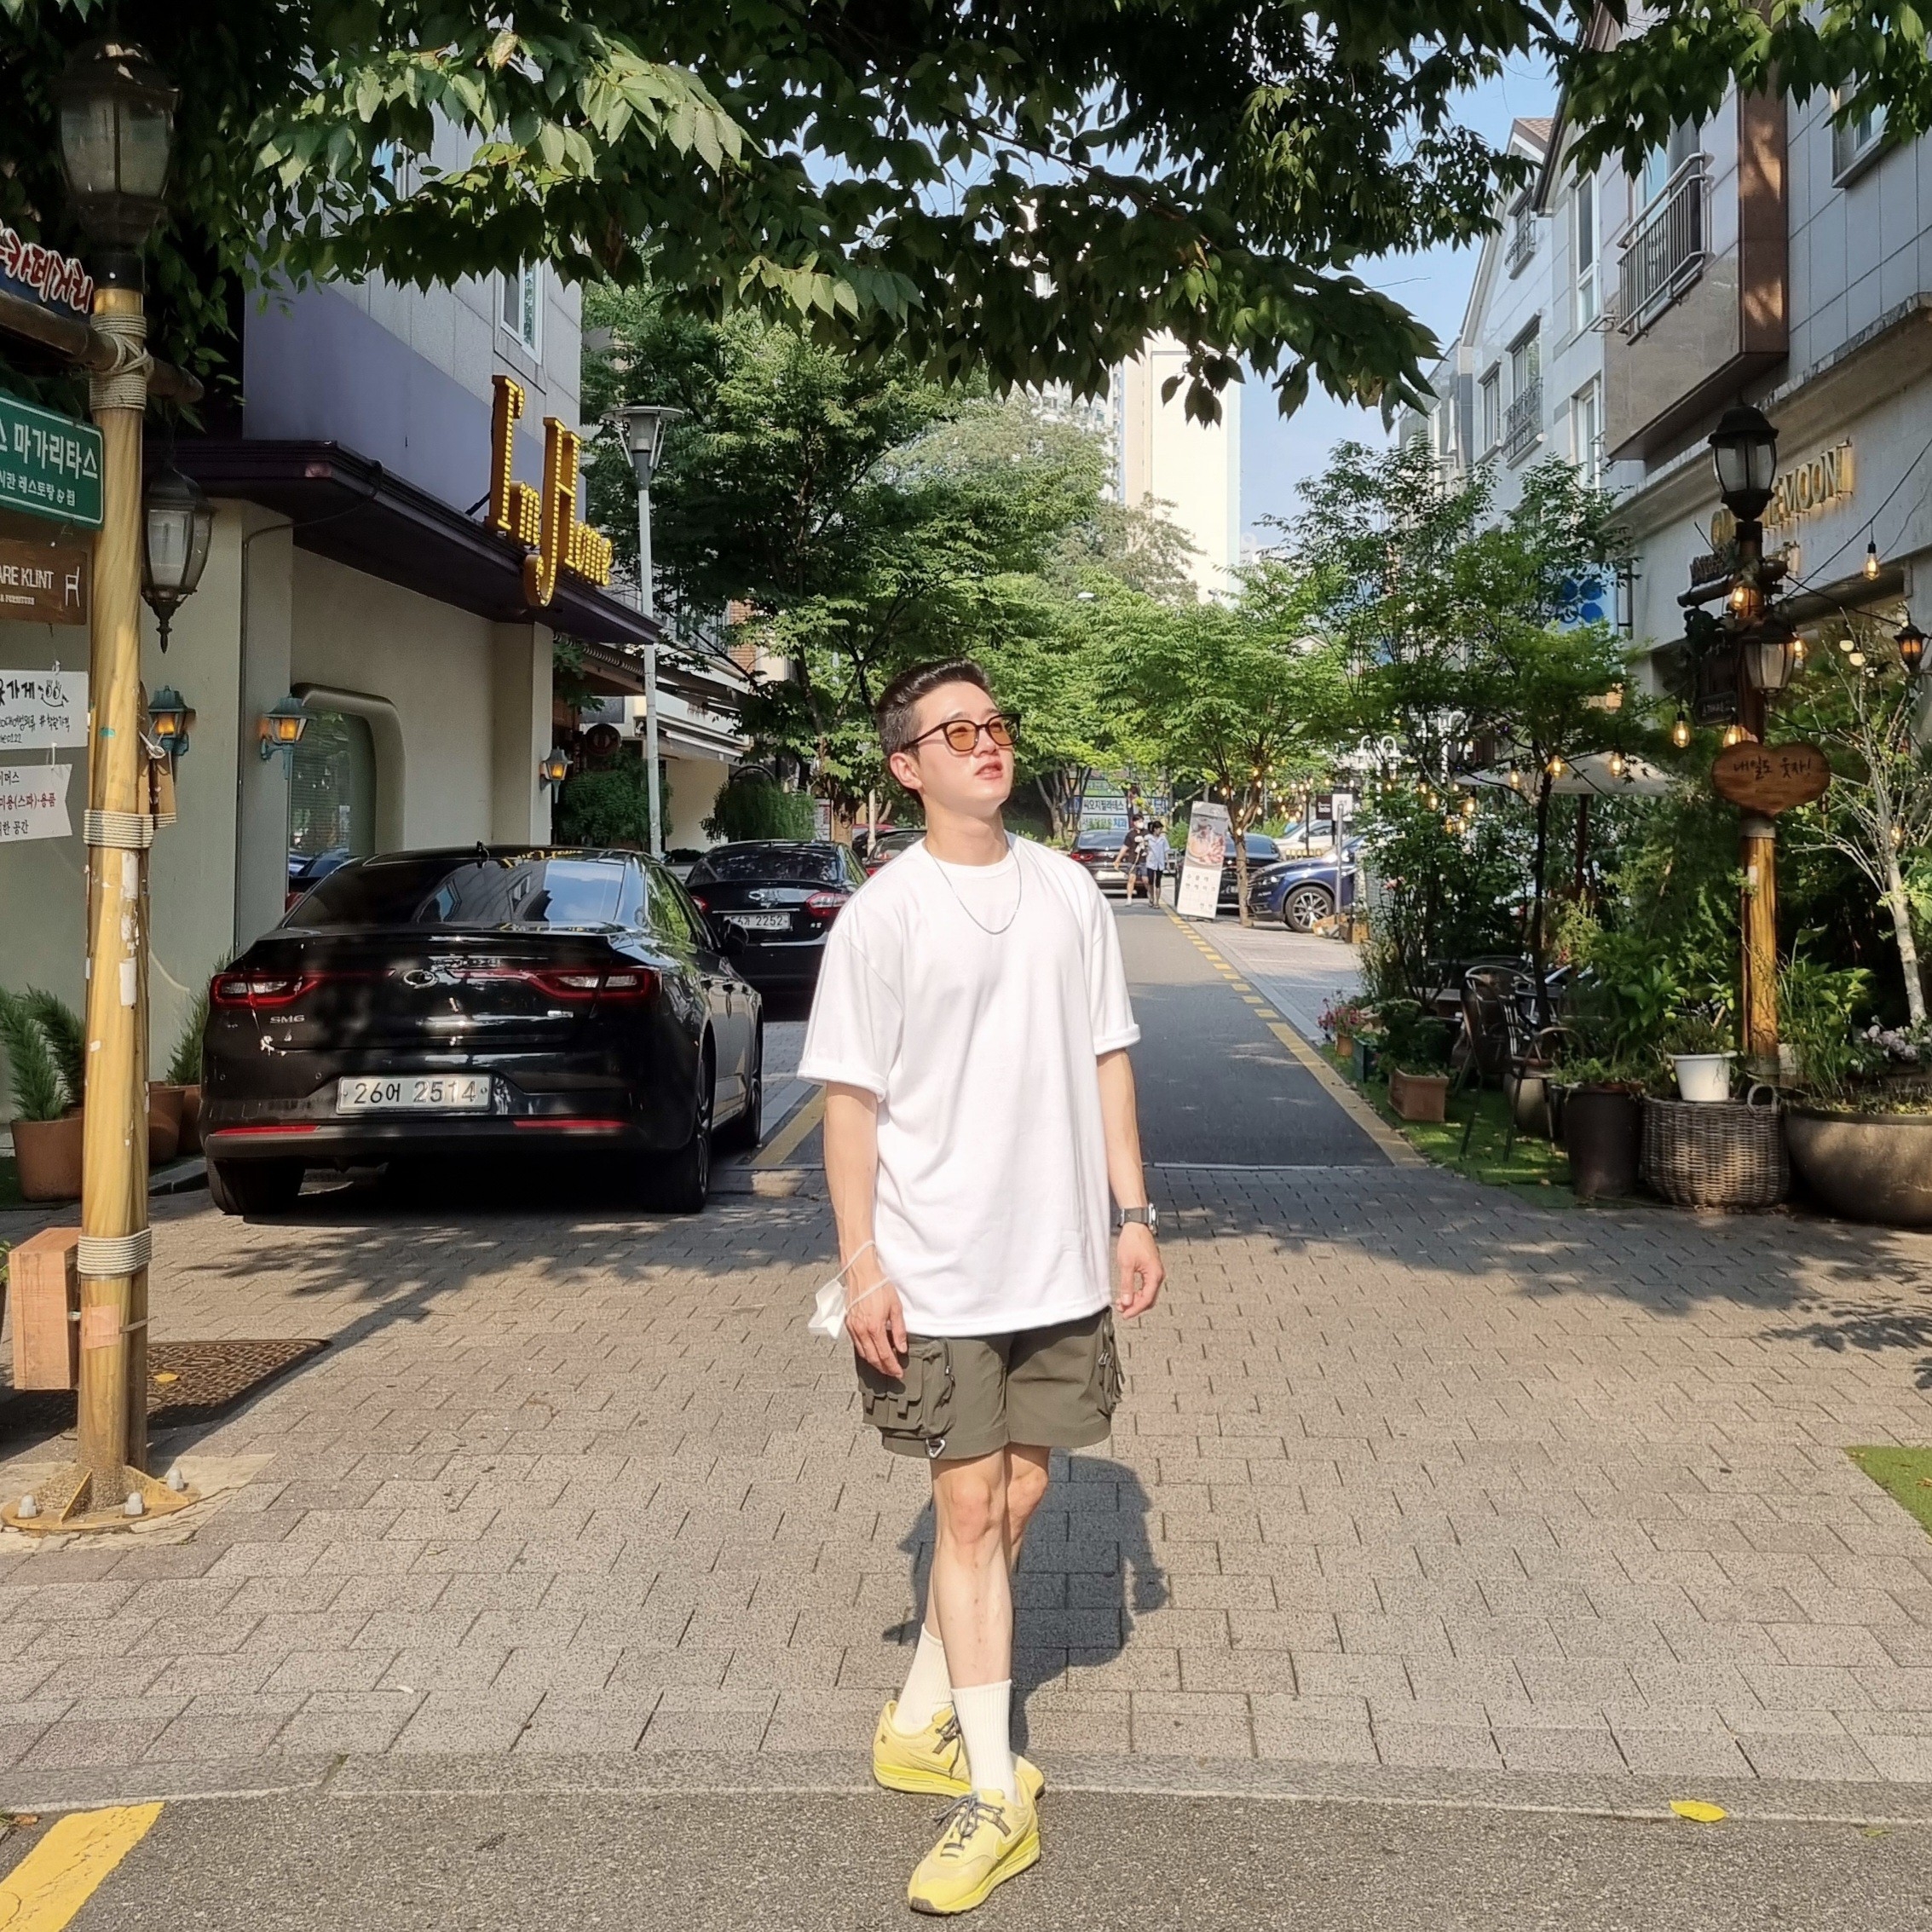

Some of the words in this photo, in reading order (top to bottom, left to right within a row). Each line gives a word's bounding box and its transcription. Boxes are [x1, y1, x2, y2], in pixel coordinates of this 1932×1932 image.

[14, 422, 98, 480] 마가리타스
[18, 475, 55, 501] 레스토랑
[56, 488, 65, 504] &
[20, 567, 55, 590] KLINT
[1733, 755, 1773, 780] 내일도
[13, 819, 29, 835] 공간
[756, 915, 782, 926] 2252
[354, 1081, 401, 1104] 26어
[413, 1081, 477, 1104] 2514
